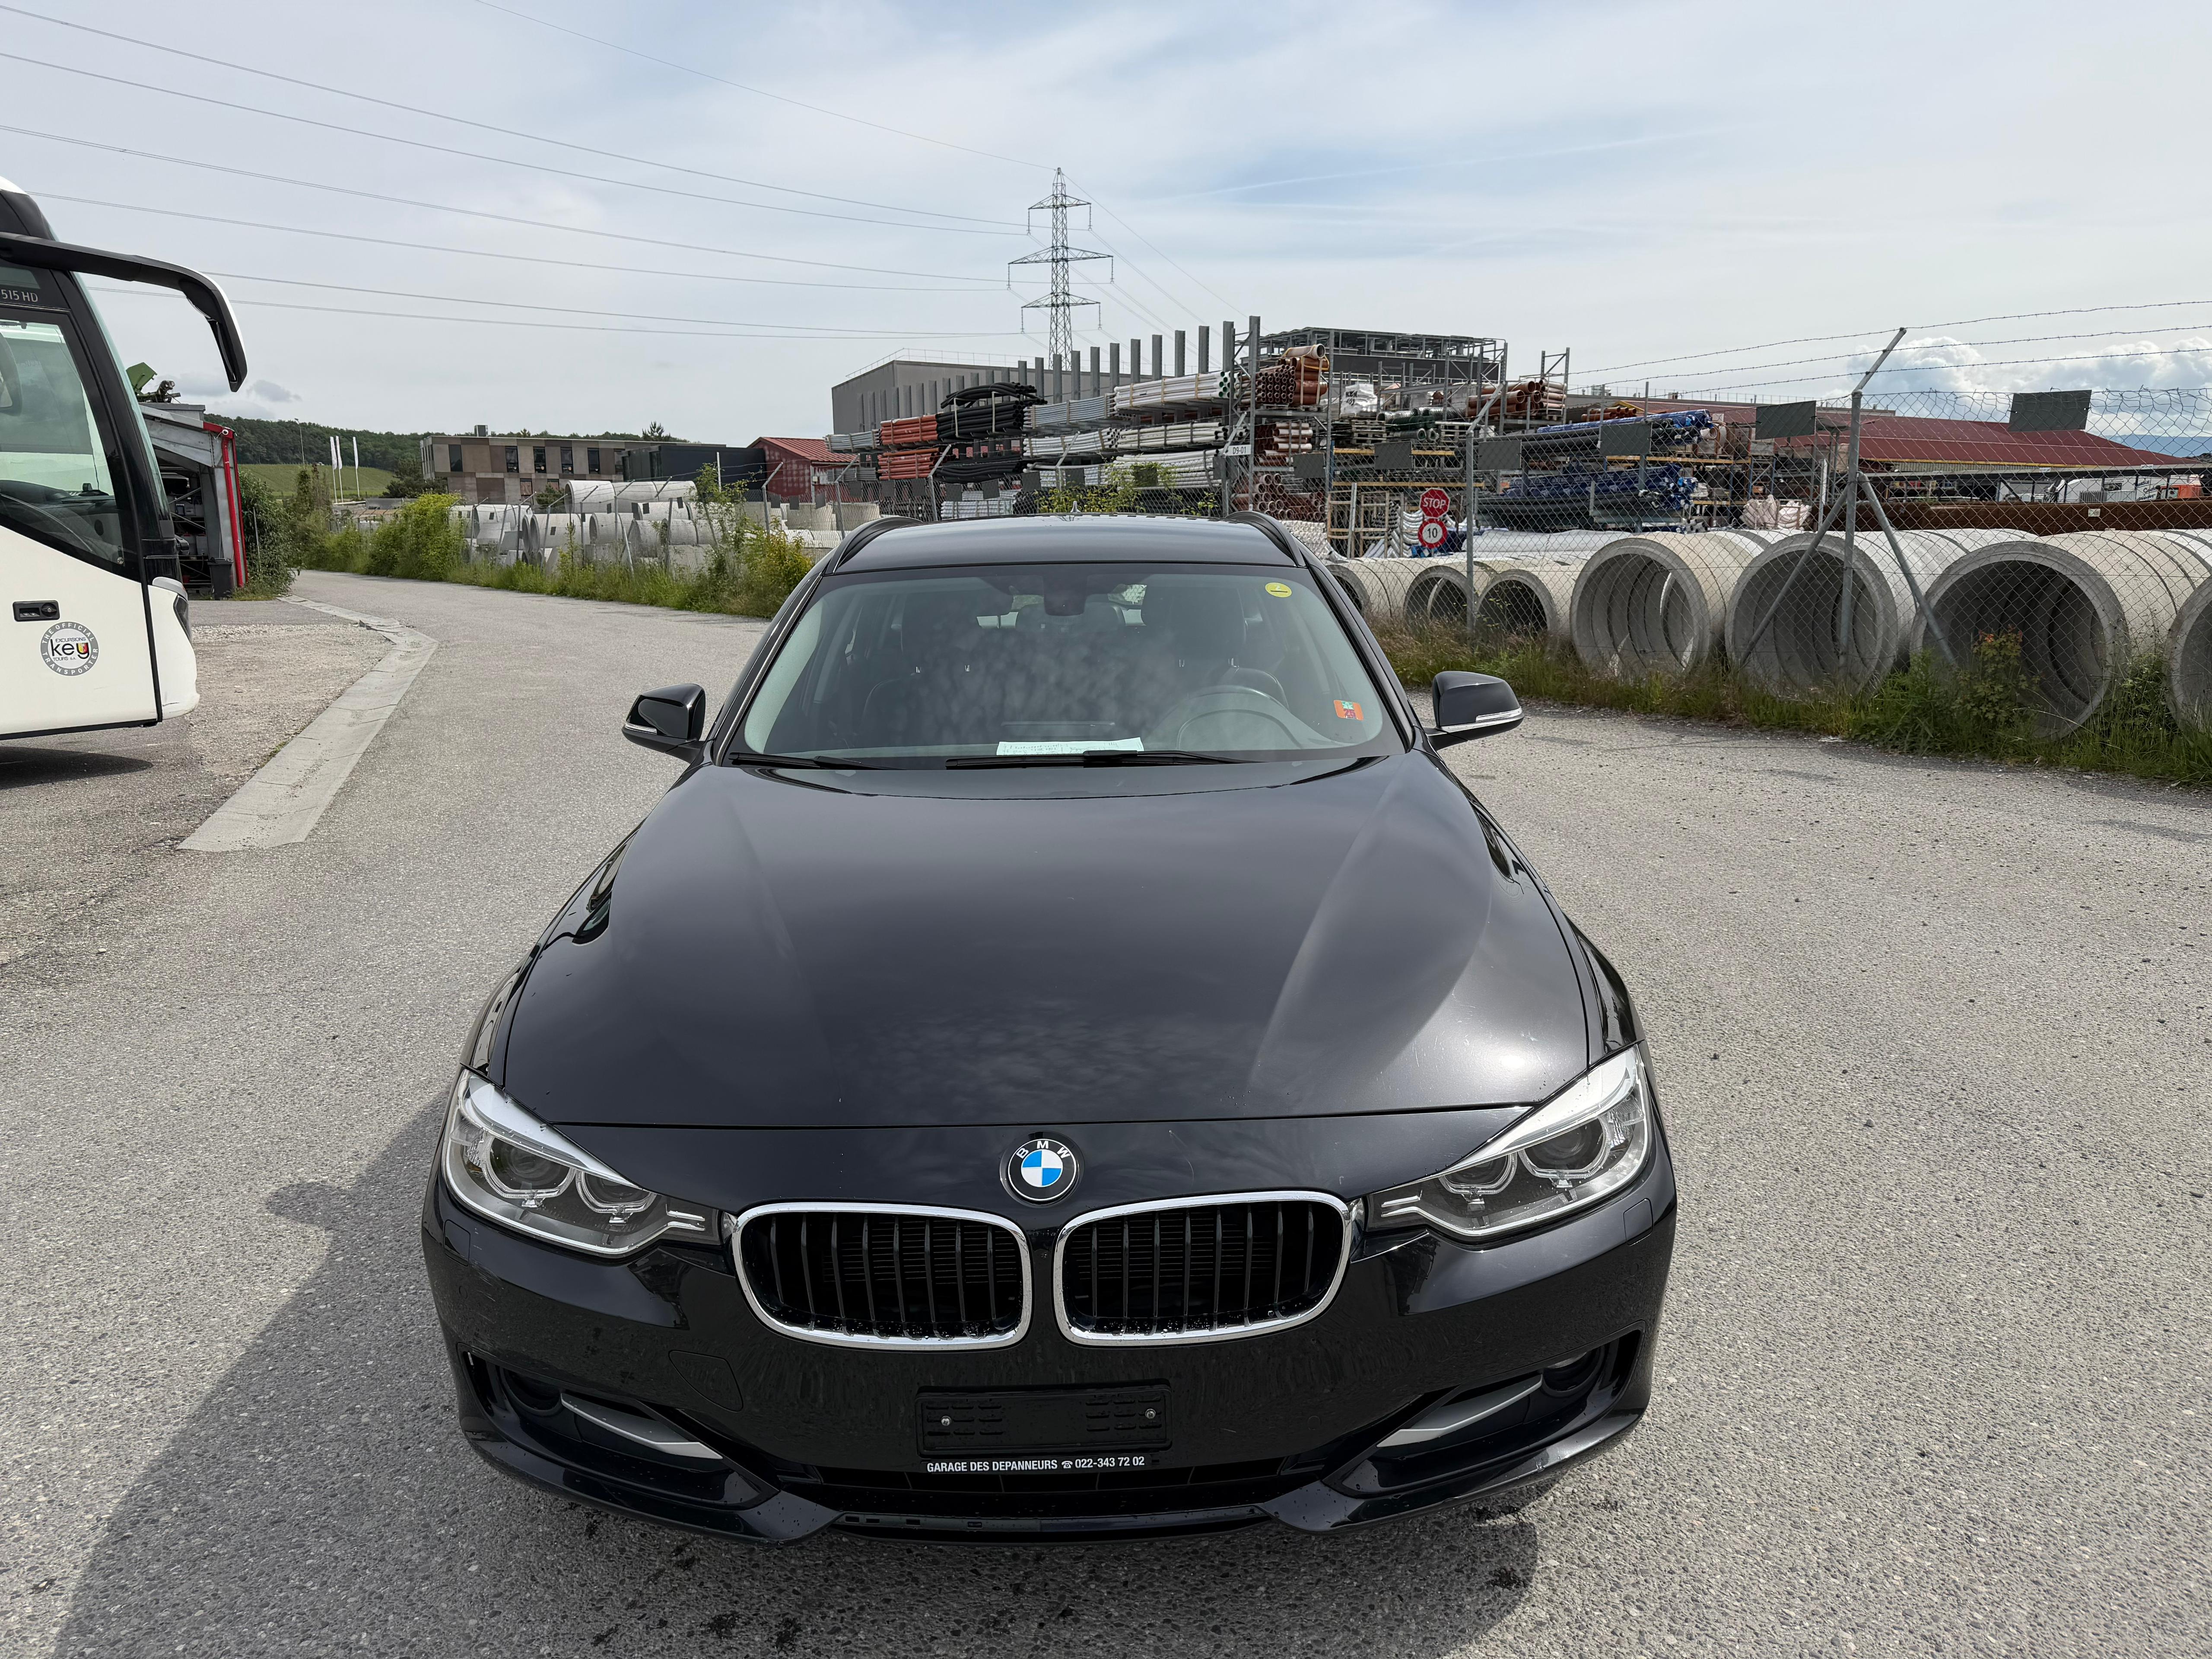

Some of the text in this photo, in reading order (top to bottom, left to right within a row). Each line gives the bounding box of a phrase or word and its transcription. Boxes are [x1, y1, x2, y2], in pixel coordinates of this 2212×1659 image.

[1, 289, 38, 302] 515 HD
[1233, 446, 1246, 454] D9-01
[1423, 497, 1446, 509] STOP
[1427, 528, 1438, 539] 10
[42, 622, 95, 644] THE OFFICIAL
[50, 639, 90, 659] key
[42, 648, 99, 675] TRANSPORTER
[1016, 1140, 1071, 1159] BMW
[927, 1456, 1145, 1472] GARAGE DES DEPANNEURS 022-343 72 02
